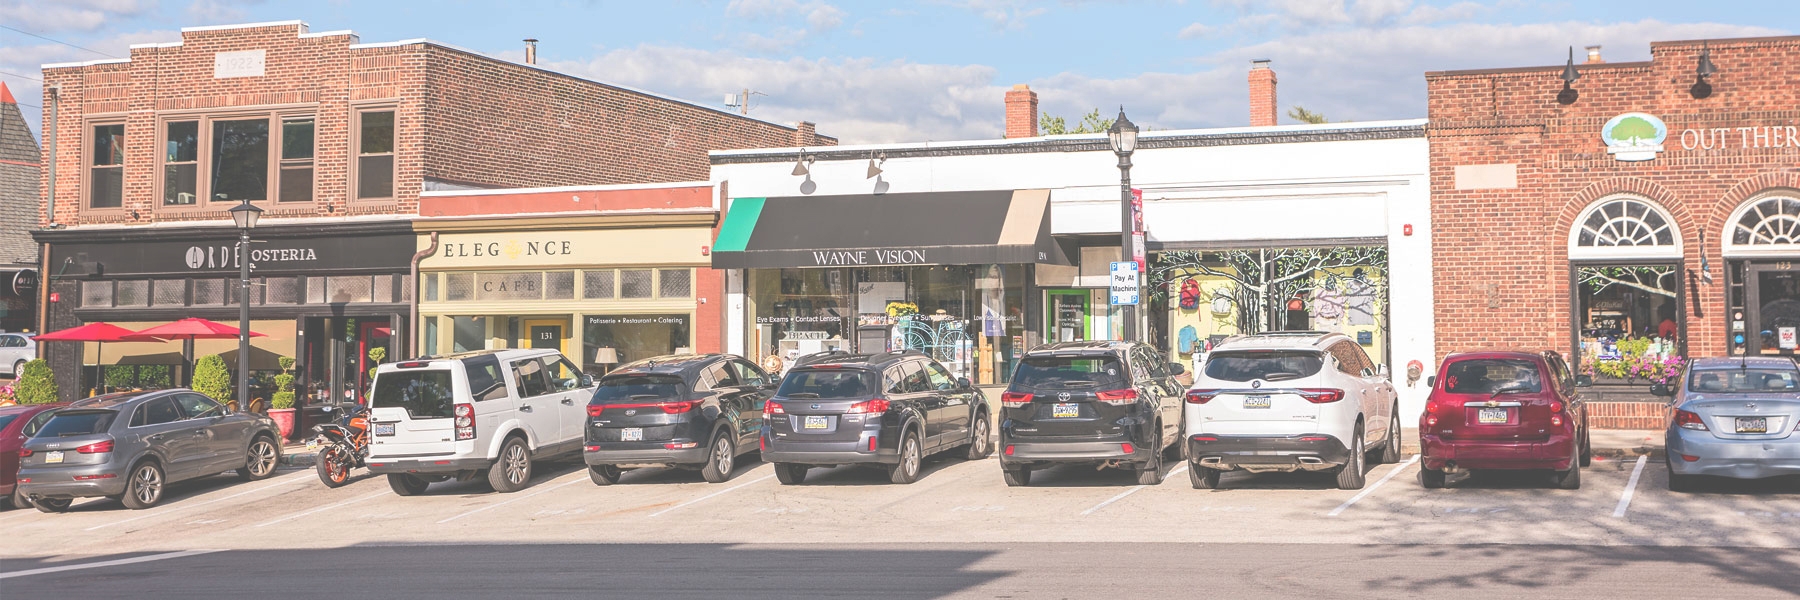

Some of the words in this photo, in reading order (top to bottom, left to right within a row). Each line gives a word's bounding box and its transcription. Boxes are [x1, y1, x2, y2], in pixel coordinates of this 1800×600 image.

[226, 57, 253, 70] 1922
[1680, 128, 1731, 150] OUT
[251, 248, 317, 261] OSTERIA
[813, 251, 868, 265] WAYNE
[875, 250, 926, 264] VISION
[1775, 261, 1792, 270] 123
[1115, 274, 1126, 282] Pay
[483, 281, 535, 292] CAFE
[658, 317, 683, 325] Catering
[540, 332, 553, 340] 131
